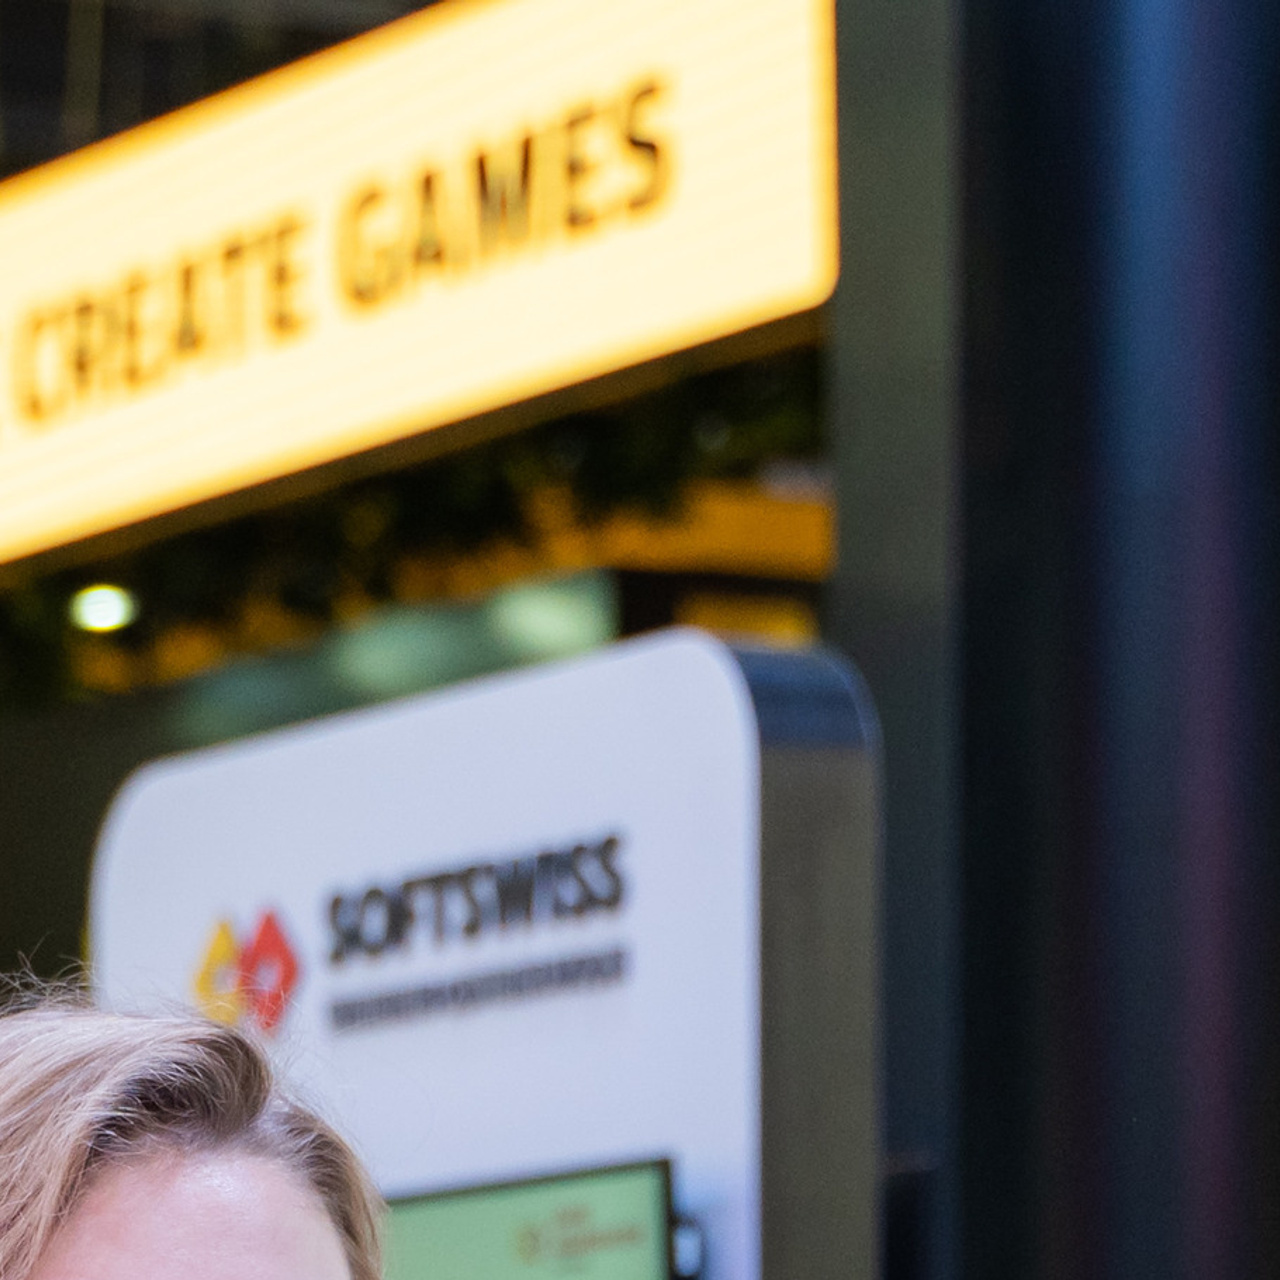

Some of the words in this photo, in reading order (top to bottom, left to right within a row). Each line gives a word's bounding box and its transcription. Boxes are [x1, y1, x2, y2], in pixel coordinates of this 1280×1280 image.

[12, 214, 308, 422] CREATE
[335, 78, 678, 313] GAMES
[329, 835, 624, 966] SOFTSWISS
